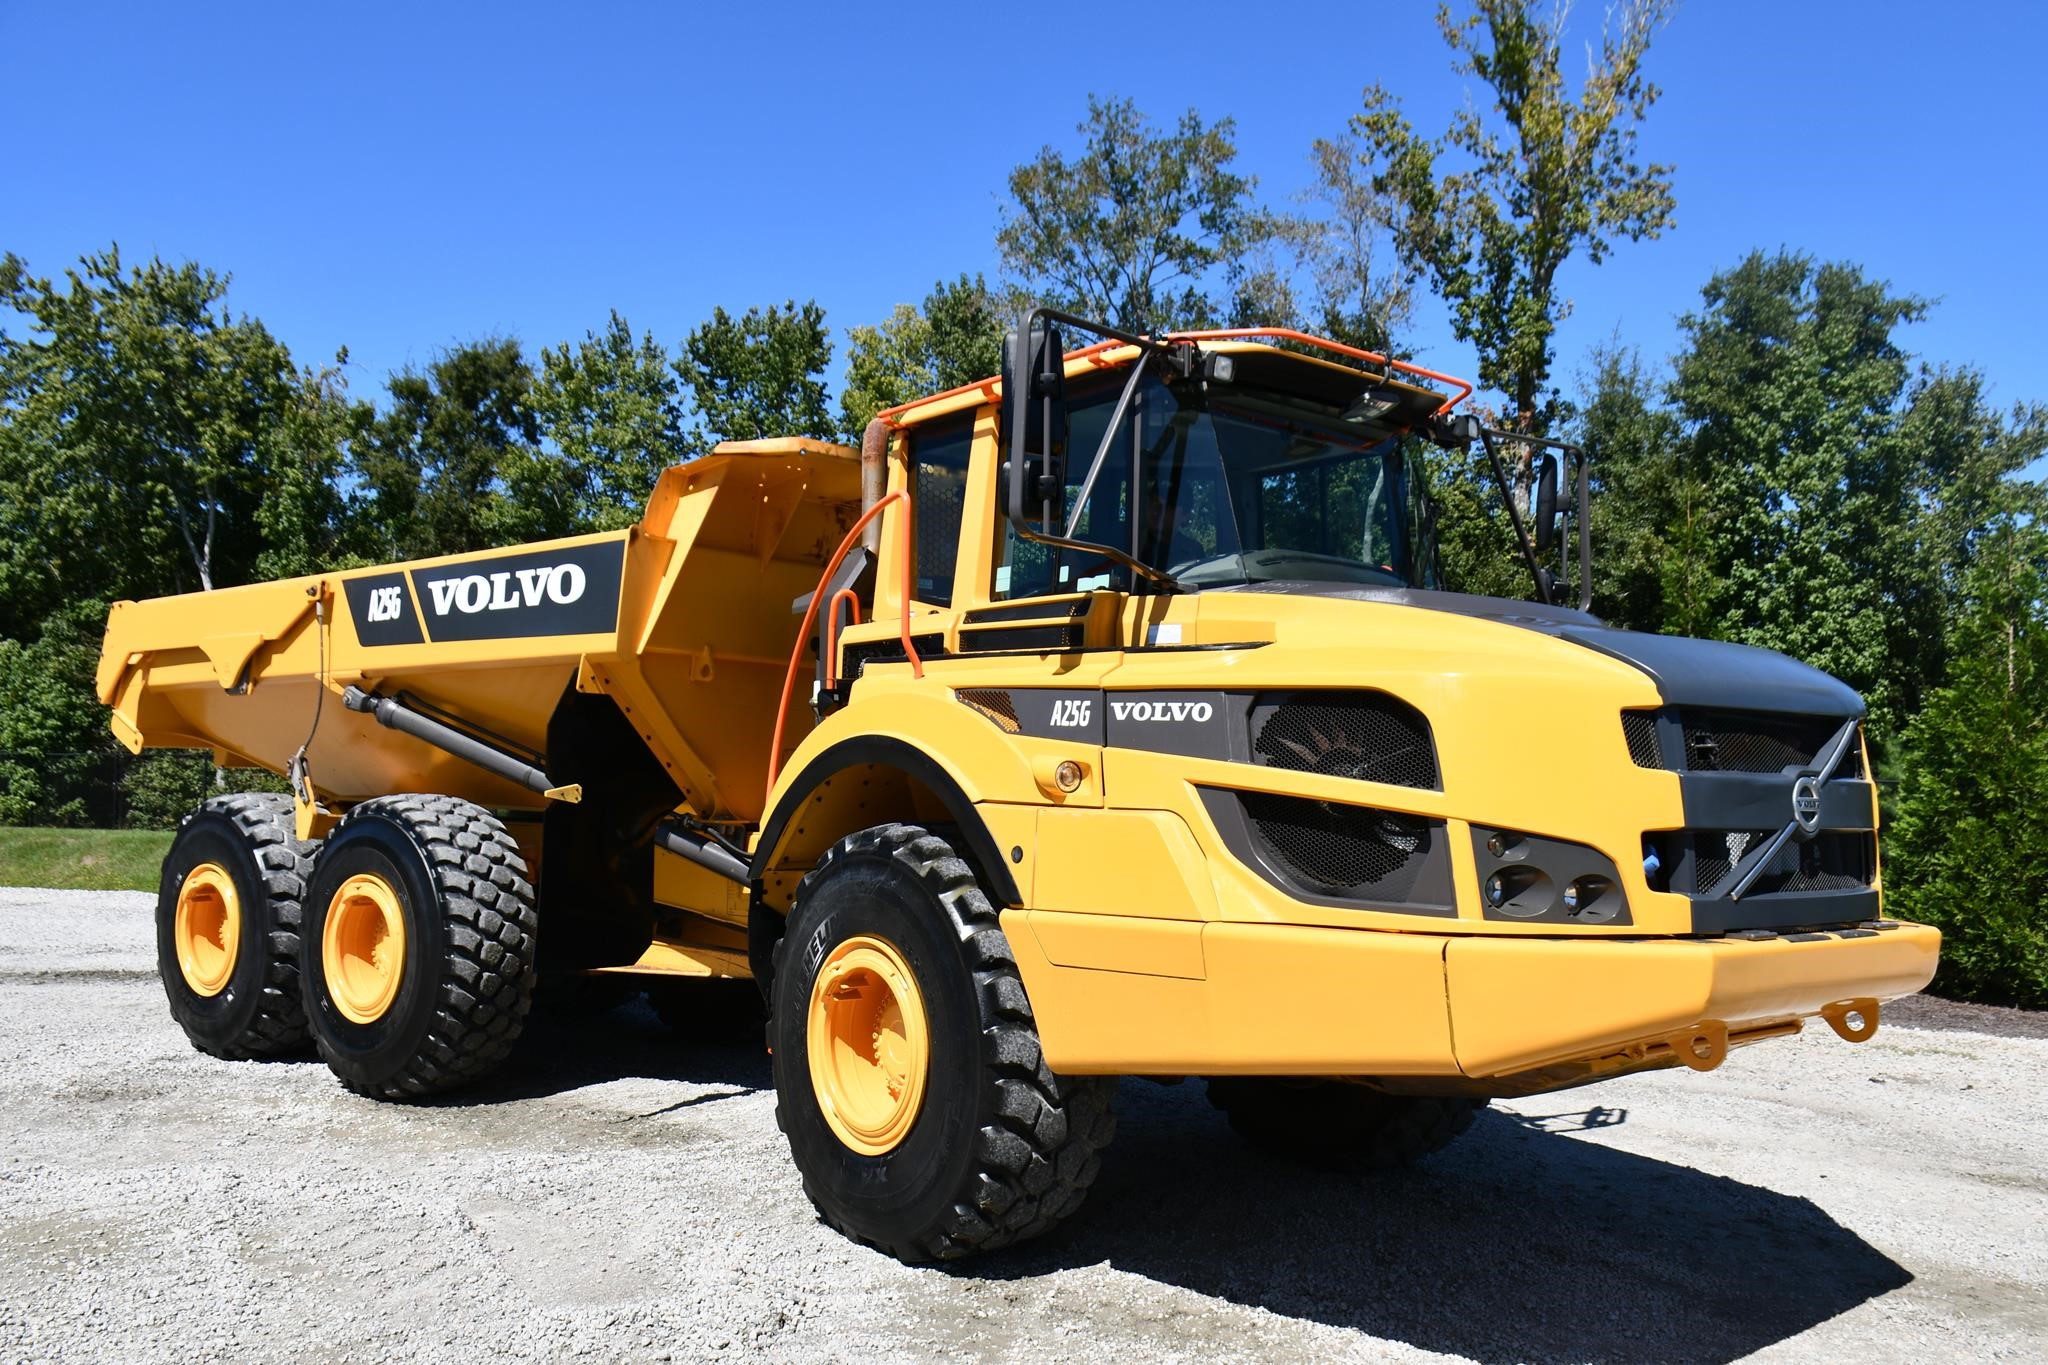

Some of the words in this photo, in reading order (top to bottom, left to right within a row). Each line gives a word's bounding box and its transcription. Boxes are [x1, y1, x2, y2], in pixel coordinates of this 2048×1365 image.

[367, 586, 402, 622] A25G
[428, 563, 586, 616] VOLVO
[1050, 699, 1091, 727] A25G
[1110, 702, 1213, 722] VOLVO
[1797, 800, 1820, 809] VOLV
